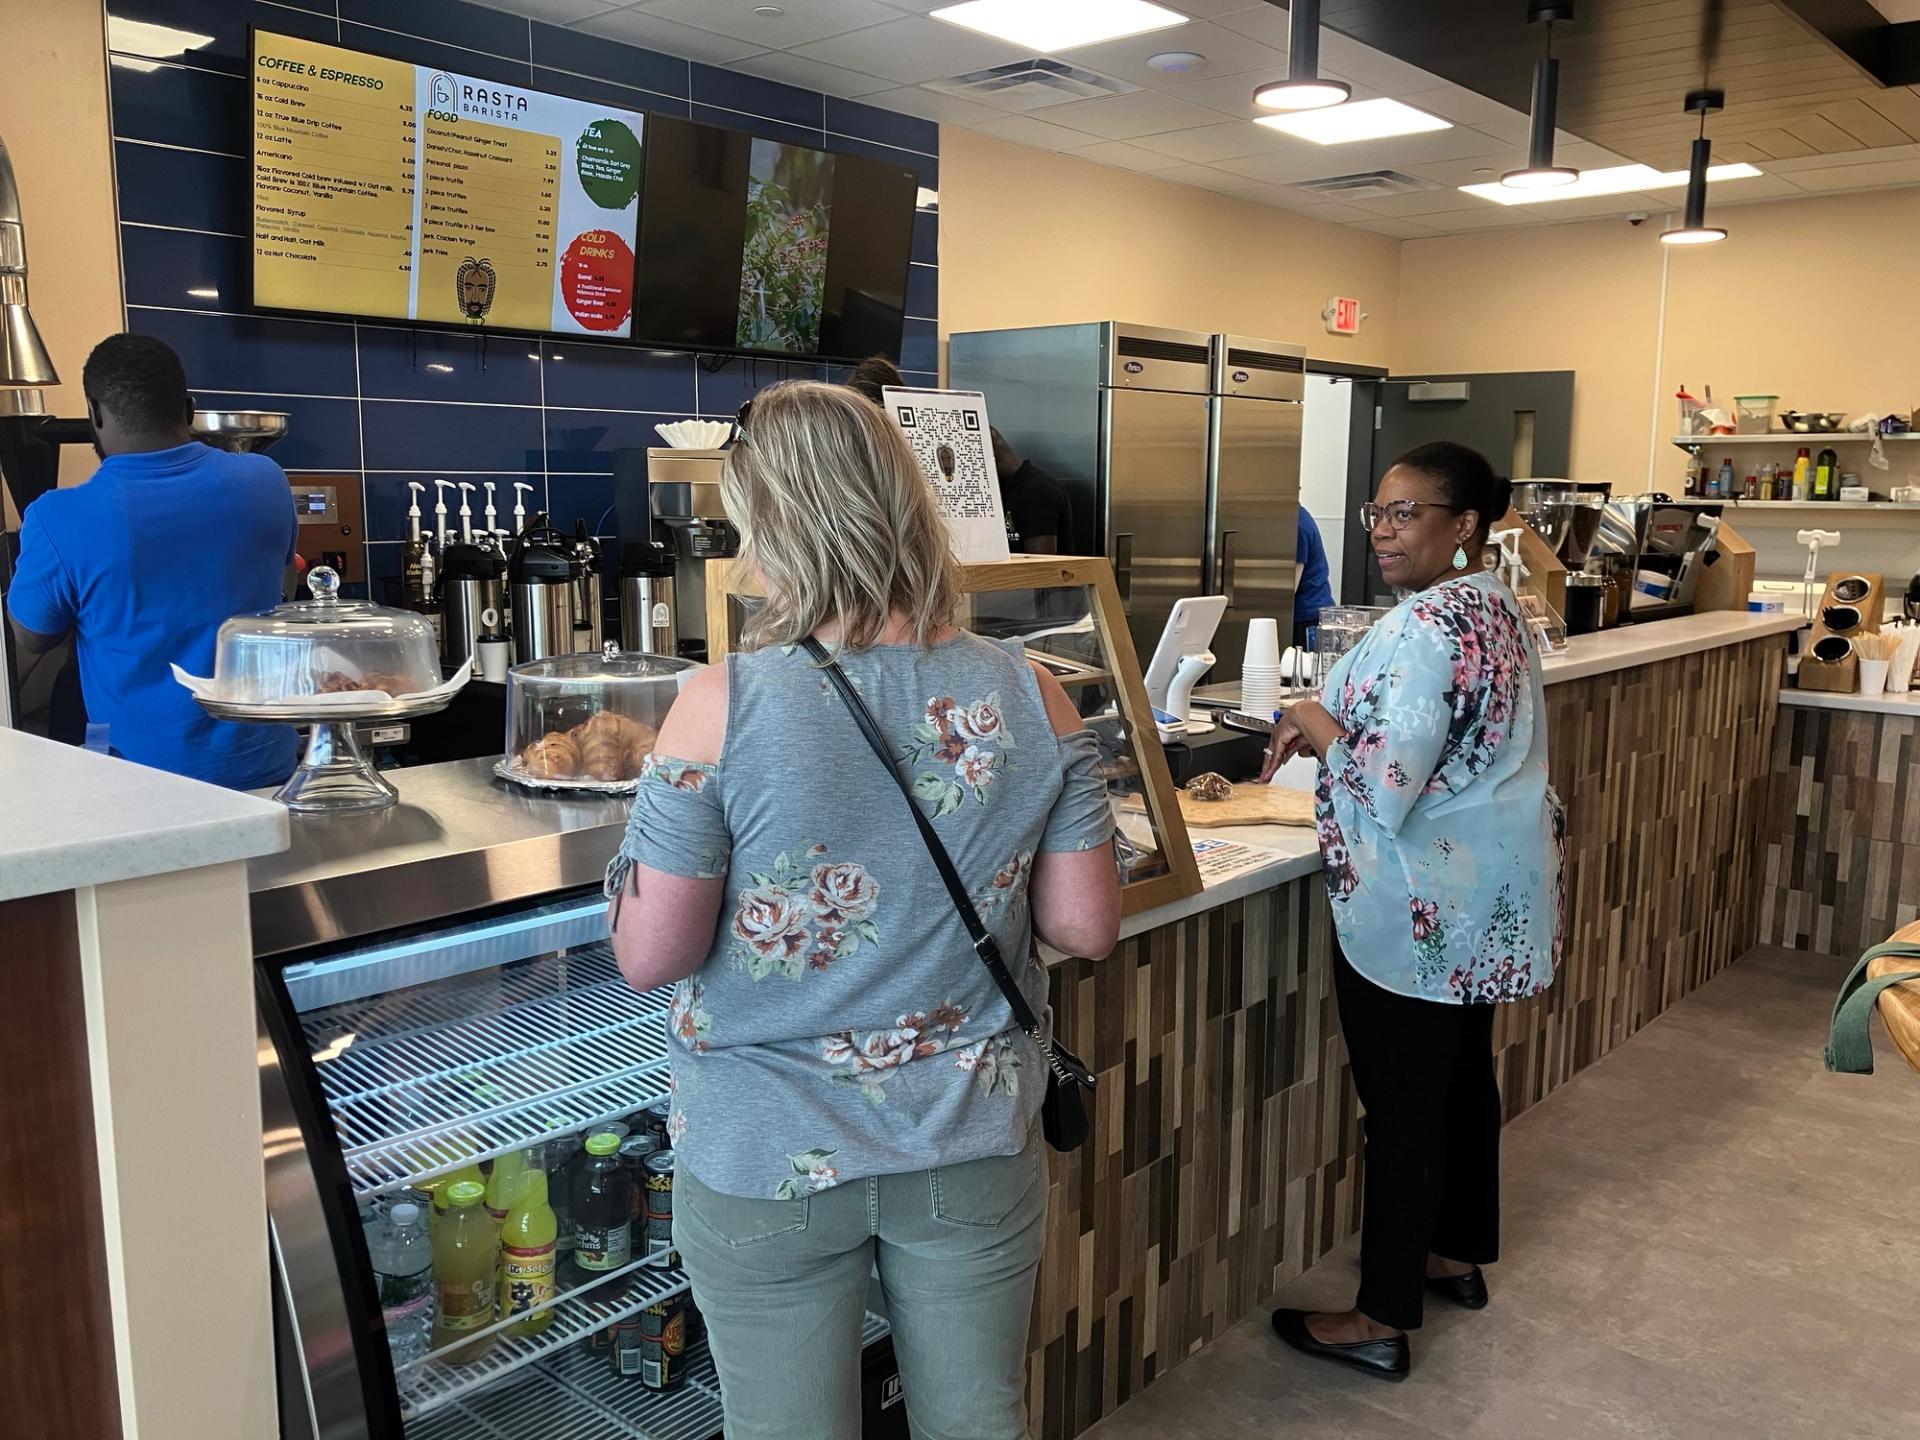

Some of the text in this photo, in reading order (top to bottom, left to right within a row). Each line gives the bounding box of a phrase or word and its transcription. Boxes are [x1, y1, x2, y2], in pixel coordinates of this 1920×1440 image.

[258, 55, 384, 90] COFFEE & ESPRESSO
[272, 79, 309, 92] Cappuccino
[275, 96, 289, 105] Cold
[463, 85, 528, 112] RASTA
[427, 108, 459, 123] FOOD
[463, 103, 519, 121] BARISTA
[256, 109, 263, 117] 12
[275, 113, 289, 121] True
[291, 116, 305, 124] Blue
[307, 119, 320, 127] Drip
[321, 122, 342, 131] Coffee
[584, 127, 602, 139] TEA
[274, 136, 292, 144] Latte
[474, 137, 492, 145] Ginger
[256, 150, 293, 160] Americano
[272, 167, 301, 178] Flavored
[302, 172, 315, 180] Cold
[312, 182, 326, 190] Blue
[357, 189, 378, 198] Coffee
[313, 190, 333, 199] Vanilla
[256, 204, 285, 214] Flavored
[287, 208, 306, 217] Syrup
[436, 235, 458, 243] Chicken
[581, 233, 606, 244] COLD
[256, 248, 263, 256] 12
[285, 252, 317, 261] Chocolate
[580, 246, 615, 259] DRINKS
